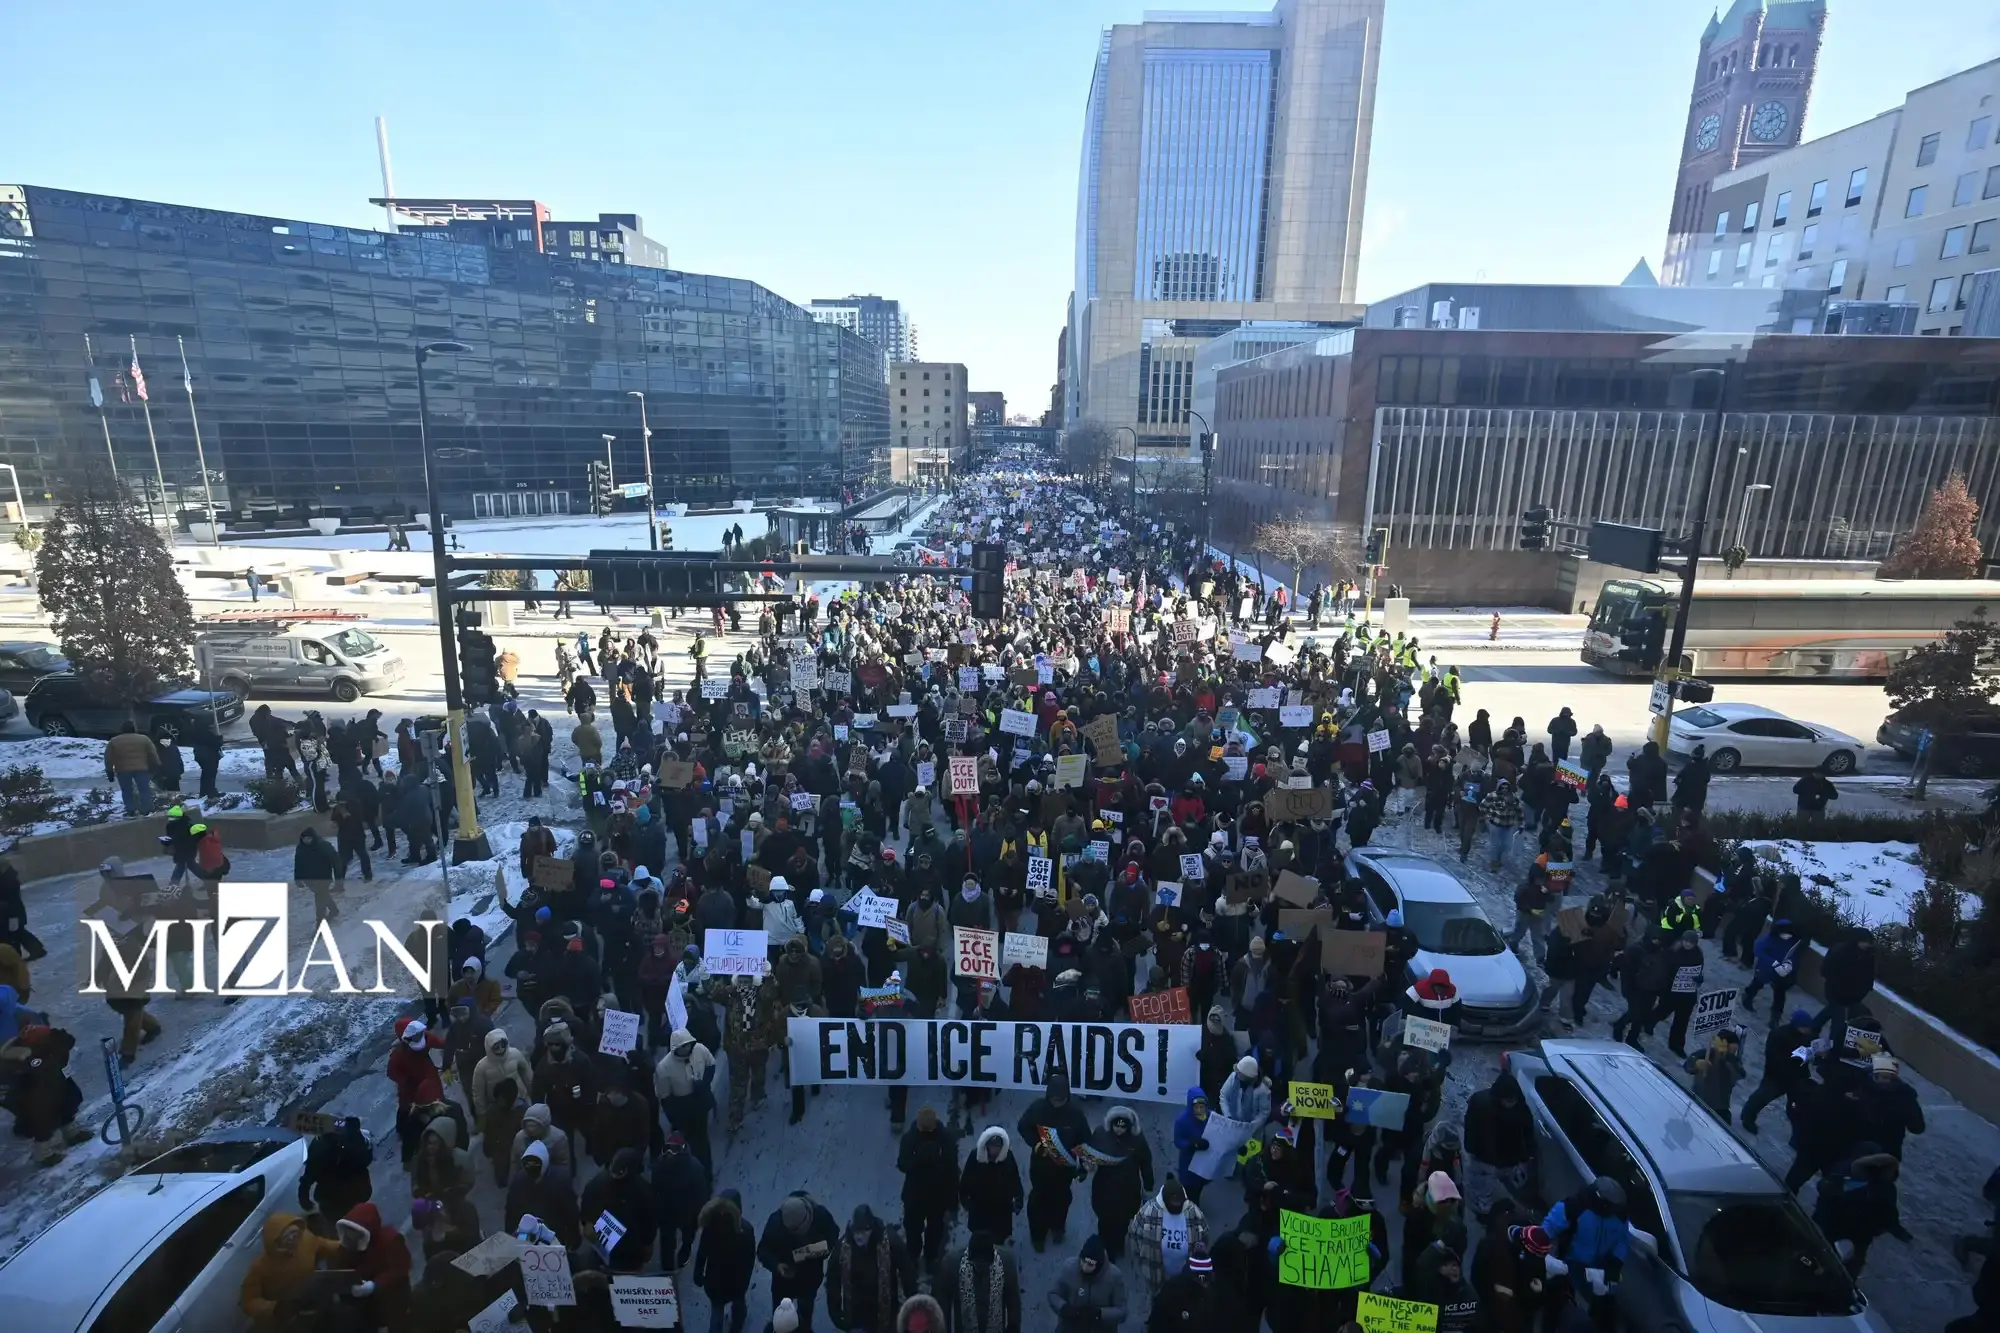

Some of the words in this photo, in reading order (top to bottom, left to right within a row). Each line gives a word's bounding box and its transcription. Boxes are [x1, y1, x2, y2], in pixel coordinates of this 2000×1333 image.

[1176, 625, 1191, 633] ICE
[795, 664, 813, 672] Rain
[828, 672, 849, 682] FUCK
[830, 682, 847, 690] ICE
[1656, 683, 1668, 694] ONE
[1654, 691, 1667, 701] WAY
[952, 764, 974, 777] ICE
[954, 778, 976, 791] OUT!
[1031, 860, 1049, 868] ICE
[1030, 867, 1048, 875] OUT
[1234, 872, 1264, 891] NO
[865, 896, 878, 906] No
[880, 901, 895, 909] one
[724, 931, 744, 946] ICE
[960, 940, 992, 959] ICE
[960, 957, 995, 976] OUT!
[1131, 990, 1186, 1018] PEOPLE
[1698, 991, 1737, 1013] STOP
[1695, 1016, 1707, 1024] ICE
[1707, 1010, 1732, 1022] TERROR
[1848, 1028, 1861, 1037] ICE
[1863, 1032, 1880, 1041] OUT
[1845, 1039, 1857, 1048] ICE
[819, 1022, 907, 1080] END
[928, 1022, 997, 1082] ICE
[1013, 1024, 1169, 1096] RAIDS!
[1295, 1087, 1310, 1096] ICE
[1313, 1088, 1329, 1097] OUT
[1295, 1095, 1330, 1109] NOW!
[1280, 1211, 1322, 1238] VICIOUS
[1330, 1219, 1366, 1238] BRUTAL
[1167, 1242, 1182, 1250] ICE
[1282, 1232, 1310, 1253] ICE
[1314, 1231, 1370, 1255] TRAITORS
[1284, 1251, 1370, 1287] SHAME
[1444, 1303, 1458, 1312] ICE
[1460, 1301, 1477, 1311] OUT
[1389, 1310, 1412, 1321] ICE
[1363, 1316, 1385, 1326] OFF
[1389, 1320, 1411, 1331] THE
